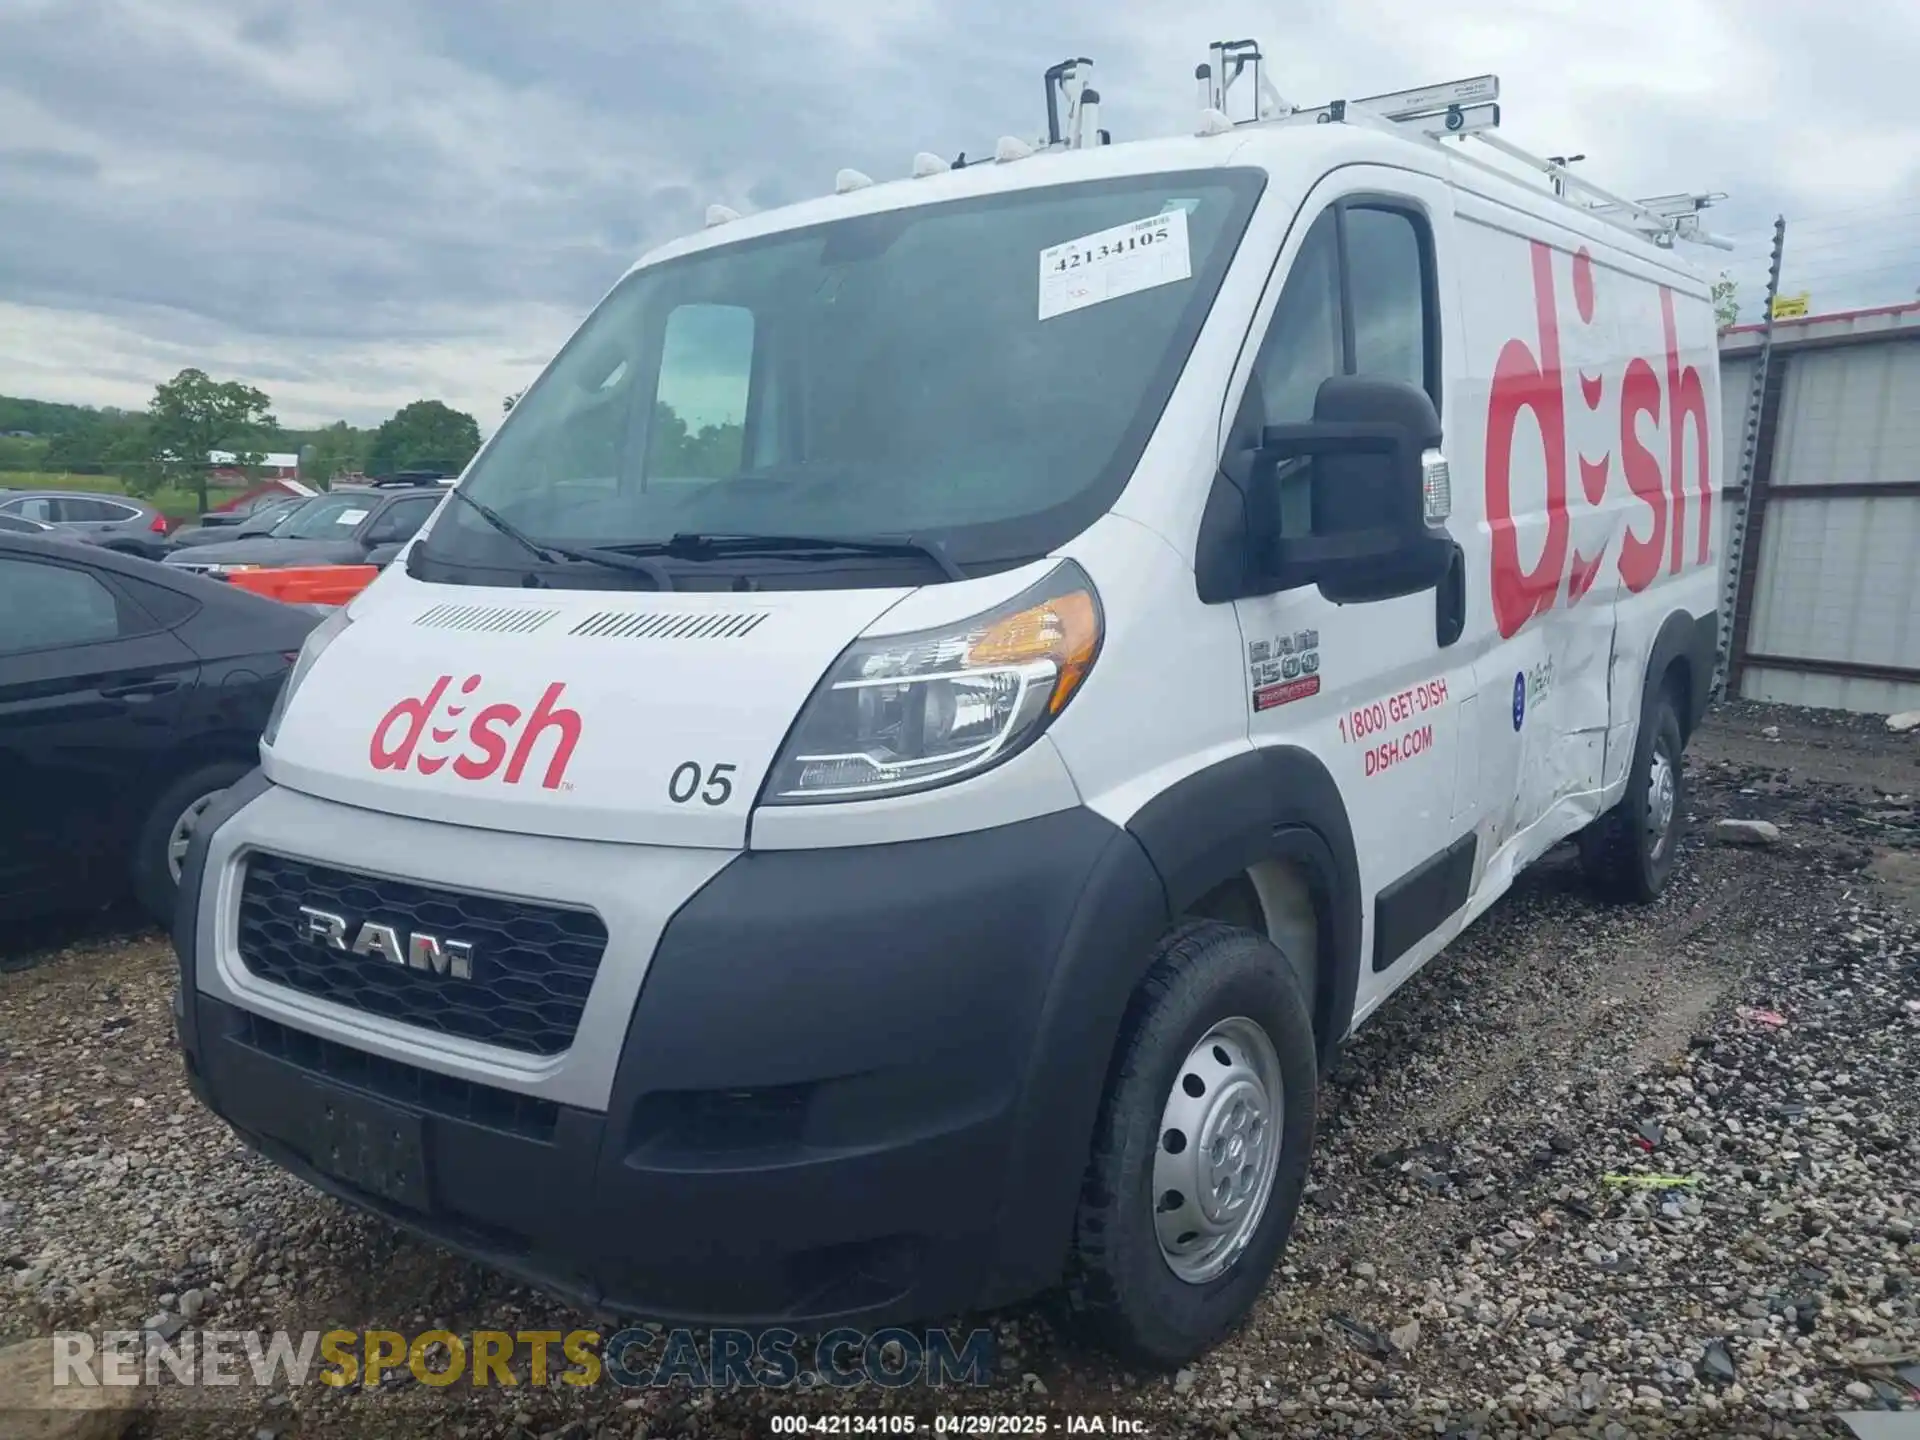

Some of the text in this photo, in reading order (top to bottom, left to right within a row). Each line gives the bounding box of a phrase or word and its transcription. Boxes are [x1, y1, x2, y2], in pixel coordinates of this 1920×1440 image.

[1054, 228, 1168, 272] 42134105
[1485, 238, 1713, 640] dish
[1388, 678, 1449, 723] GET-DISH
[369, 673, 583, 790] dish
[1365, 724, 1433, 777] DISH.COM
[668, 760, 737, 806] 05
[299, 905, 473, 980] RAM
